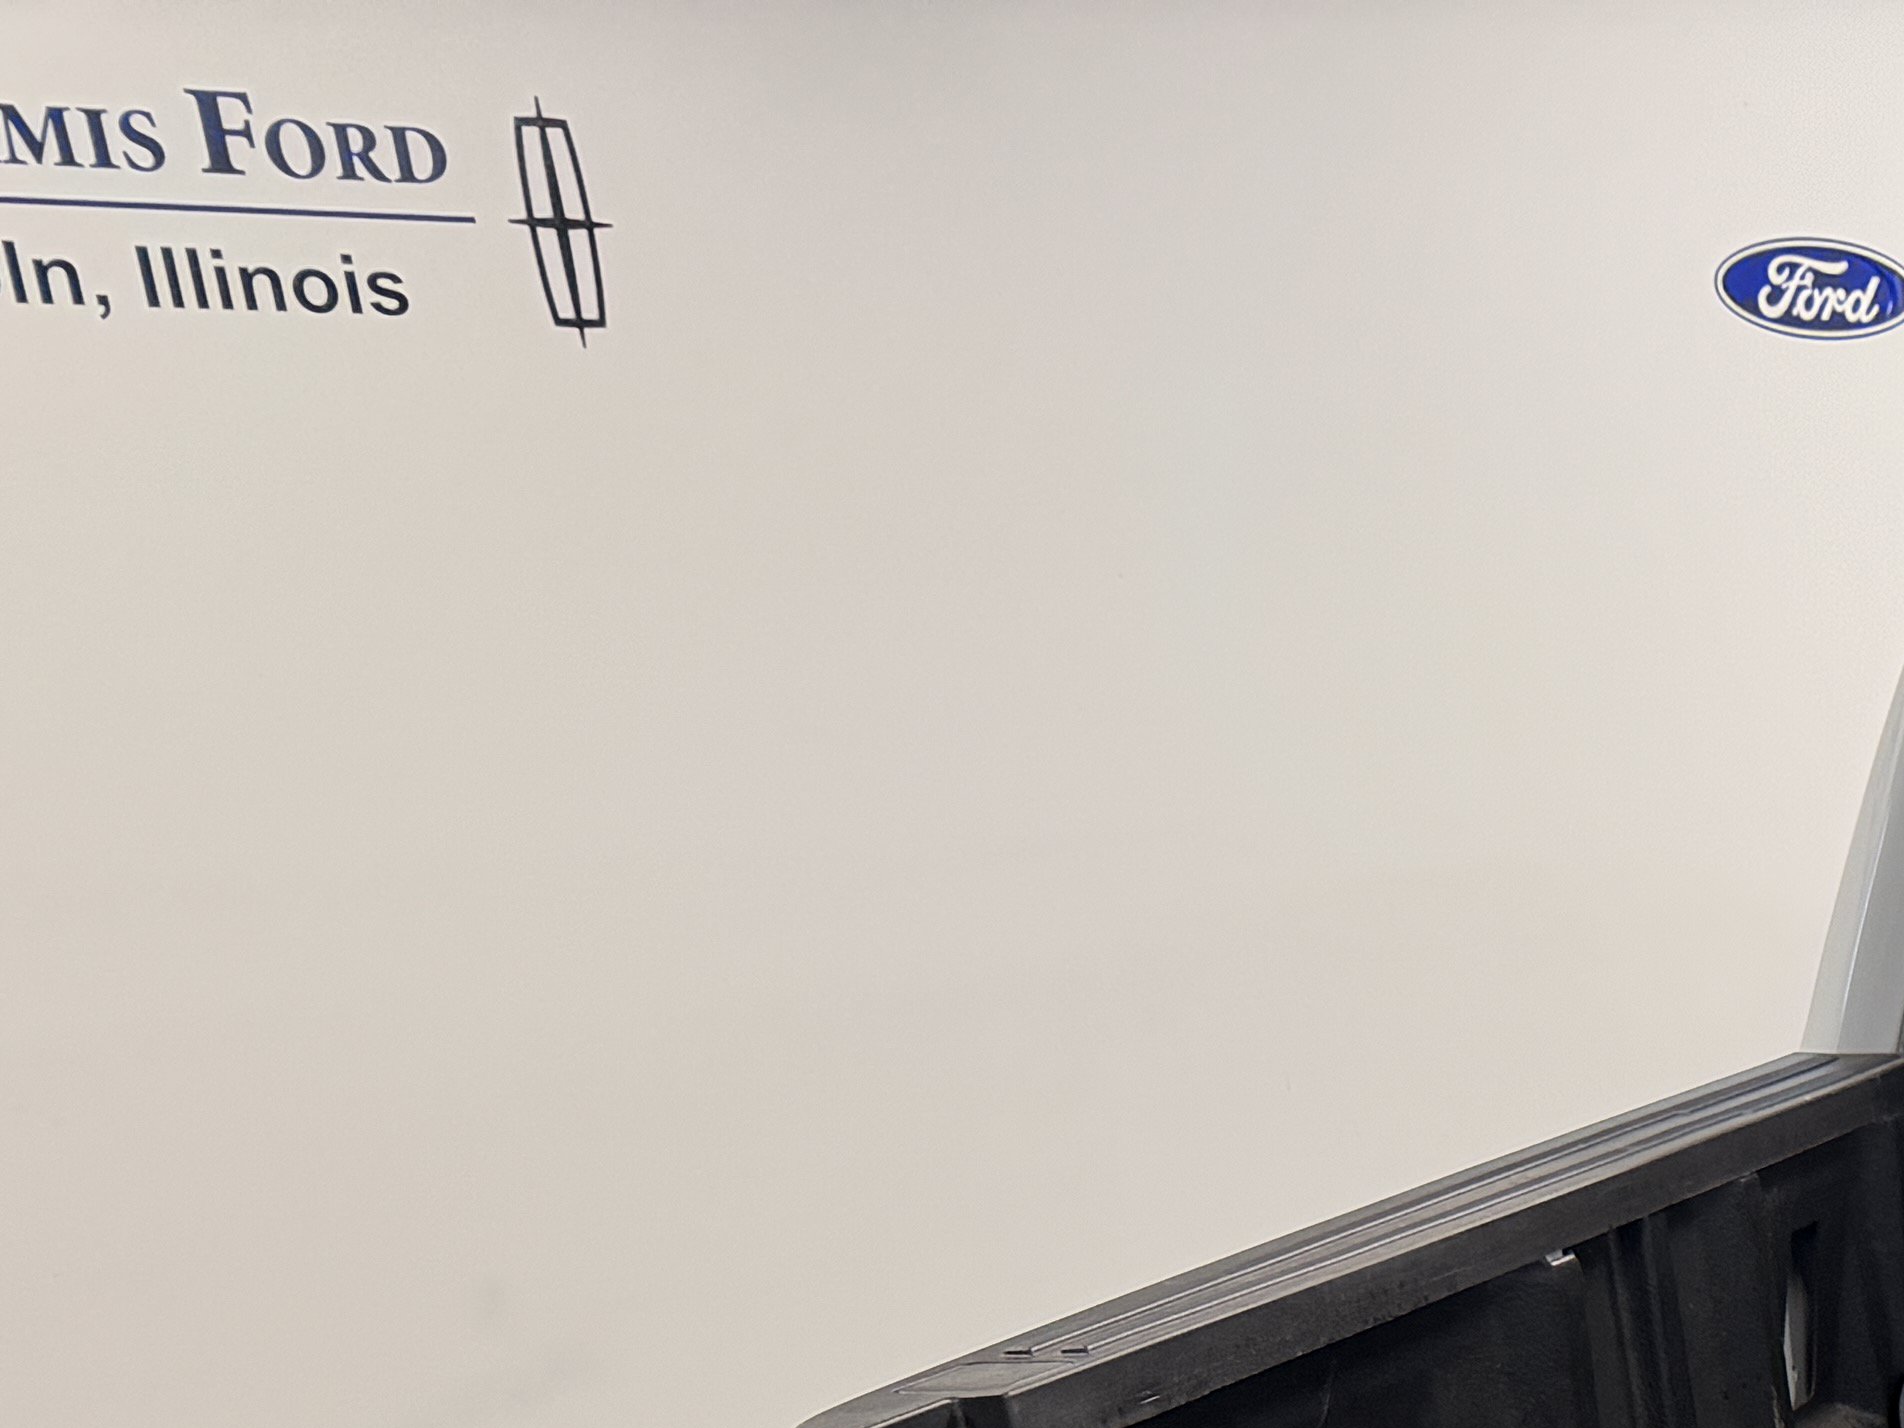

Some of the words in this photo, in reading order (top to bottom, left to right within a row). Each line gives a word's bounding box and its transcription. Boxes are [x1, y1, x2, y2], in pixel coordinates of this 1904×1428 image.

[183, 88, 448, 184] FORD
[134, 245, 410, 317] Illinois
[1757, 253, 1881, 324] Ford
